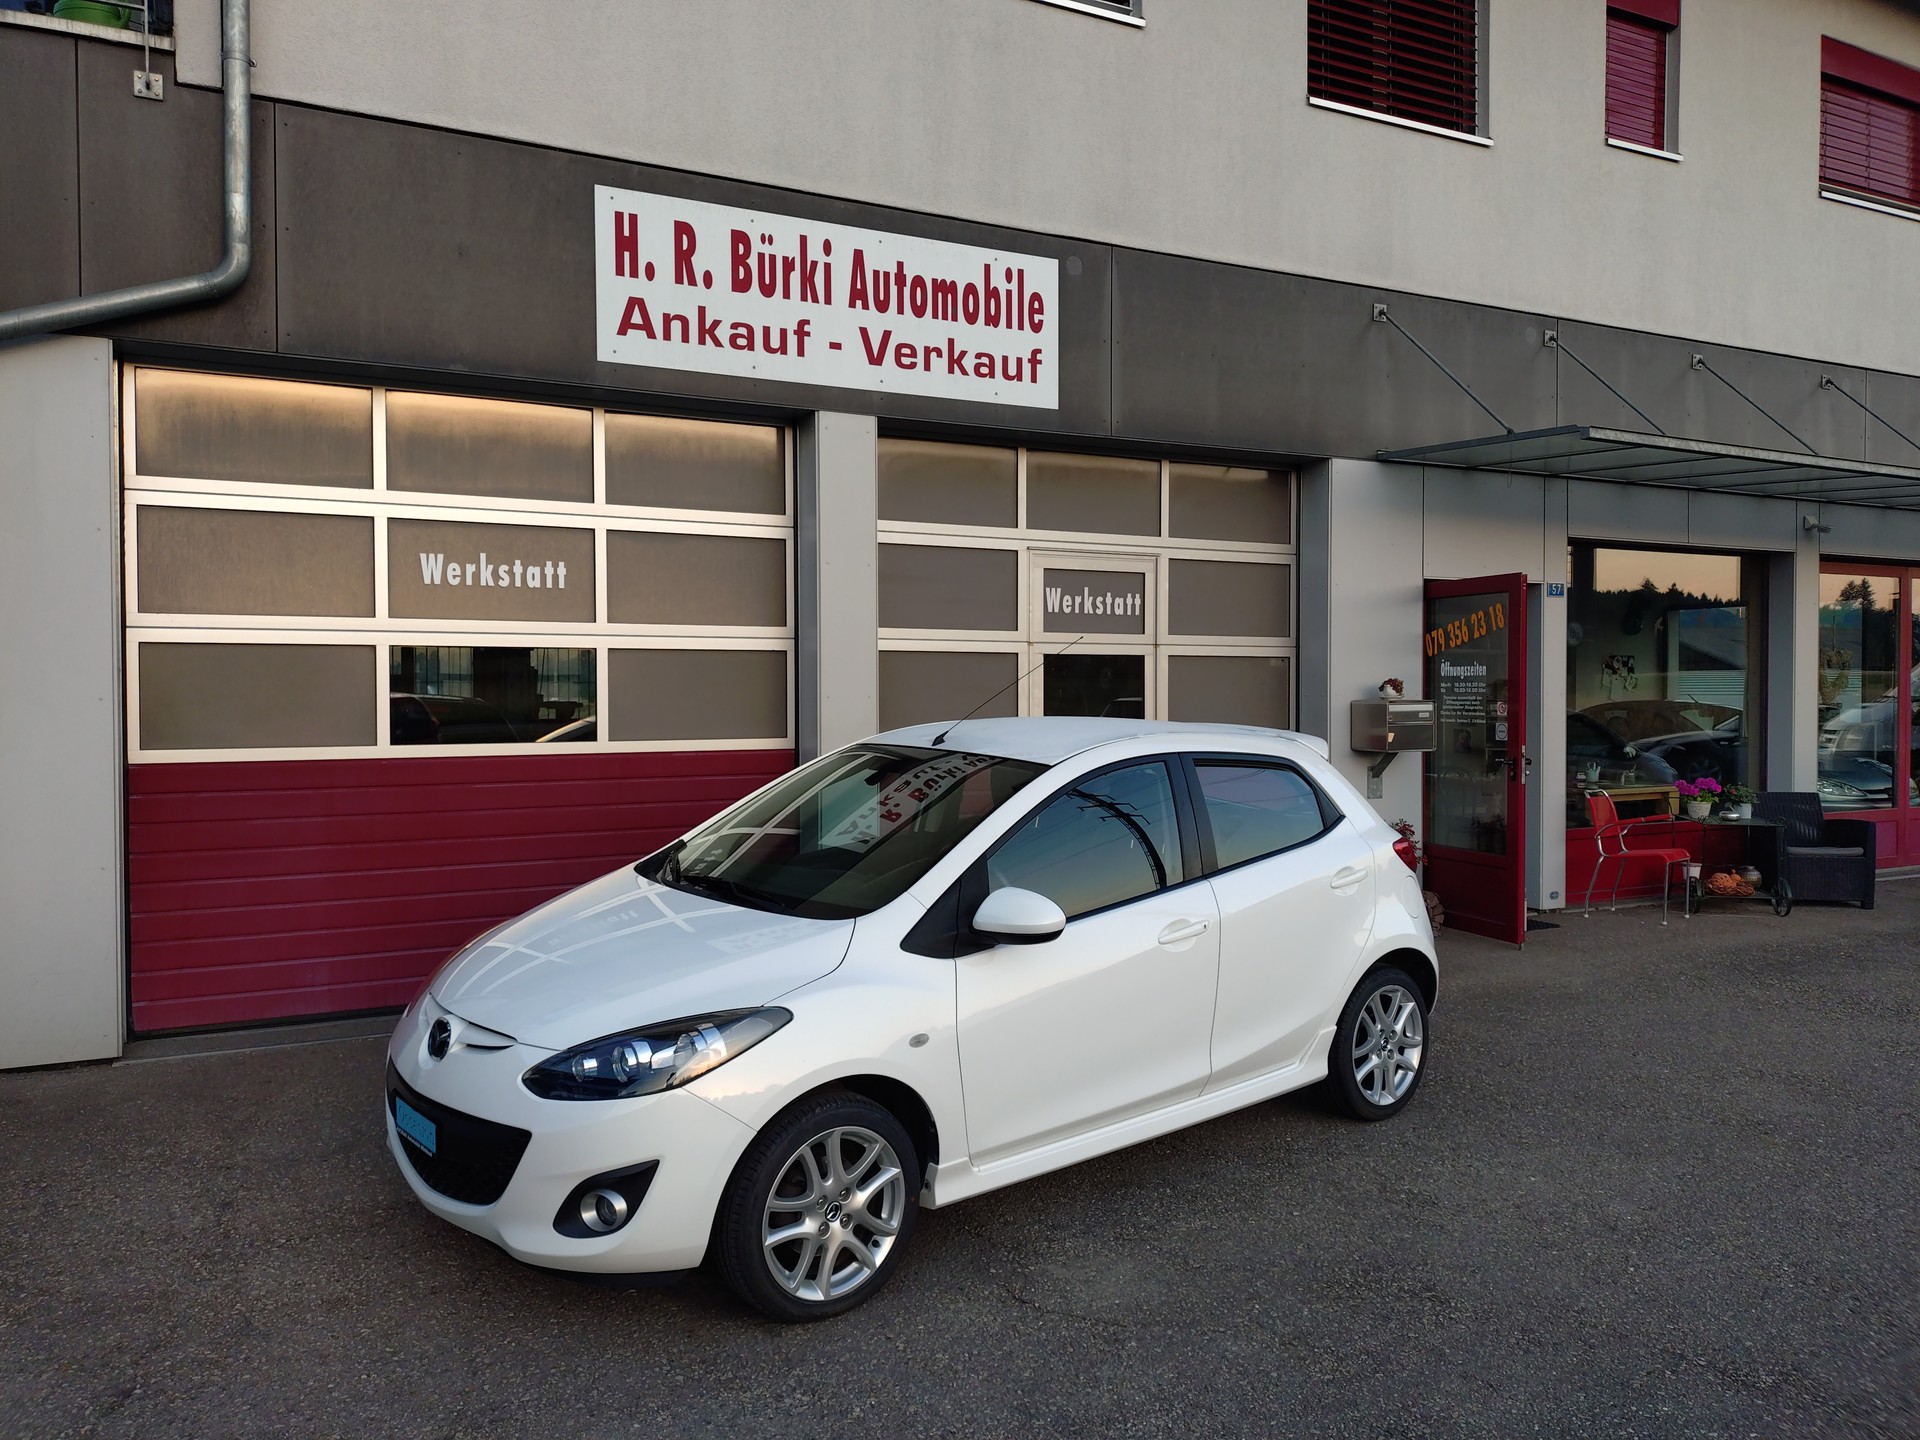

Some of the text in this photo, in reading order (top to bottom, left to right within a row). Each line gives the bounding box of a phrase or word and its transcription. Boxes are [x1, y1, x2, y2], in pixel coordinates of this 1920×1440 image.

[614, 210, 1045, 334] H. R. Bürki Automobile
[616, 295, 811, 358] Ankauf
[858, 325, 1043, 384] Verkauf
[419, 552, 567, 589] Werkstatt
[1045, 586, 1141, 616] Werkstatt
[1551, 584, 1562, 595] 57
[1425, 603, 1505, 657] 079 356 23 18
[1440, 659, 1487, 680] Öffnungszeiten
